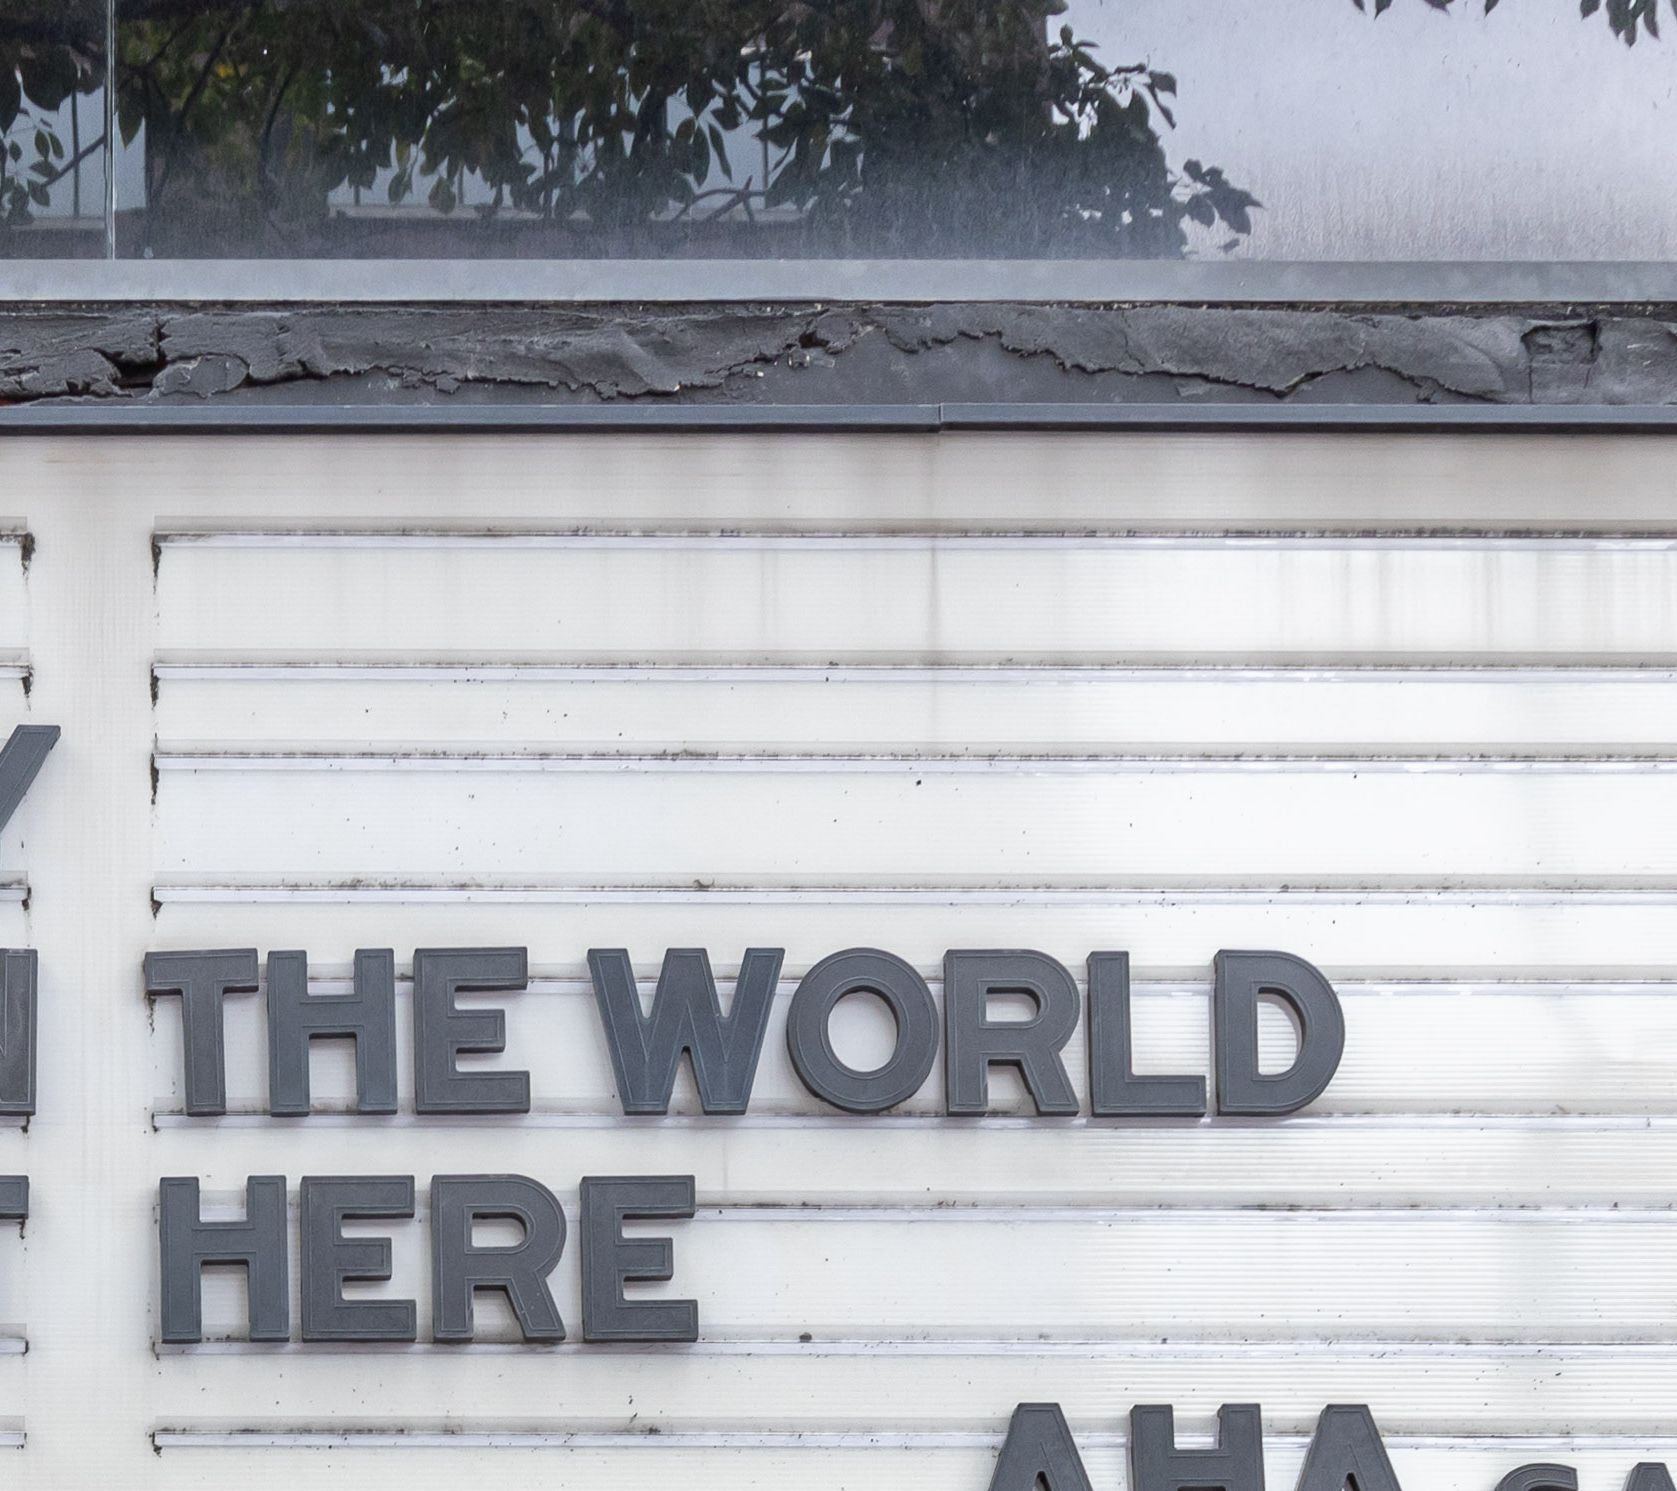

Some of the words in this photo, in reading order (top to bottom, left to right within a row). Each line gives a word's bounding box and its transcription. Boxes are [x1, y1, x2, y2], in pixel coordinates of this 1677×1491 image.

[144, 946, 532, 1118] THE
[586, 946, 1346, 1118] WORLD
[158, 1174, 698, 1343] HERE
